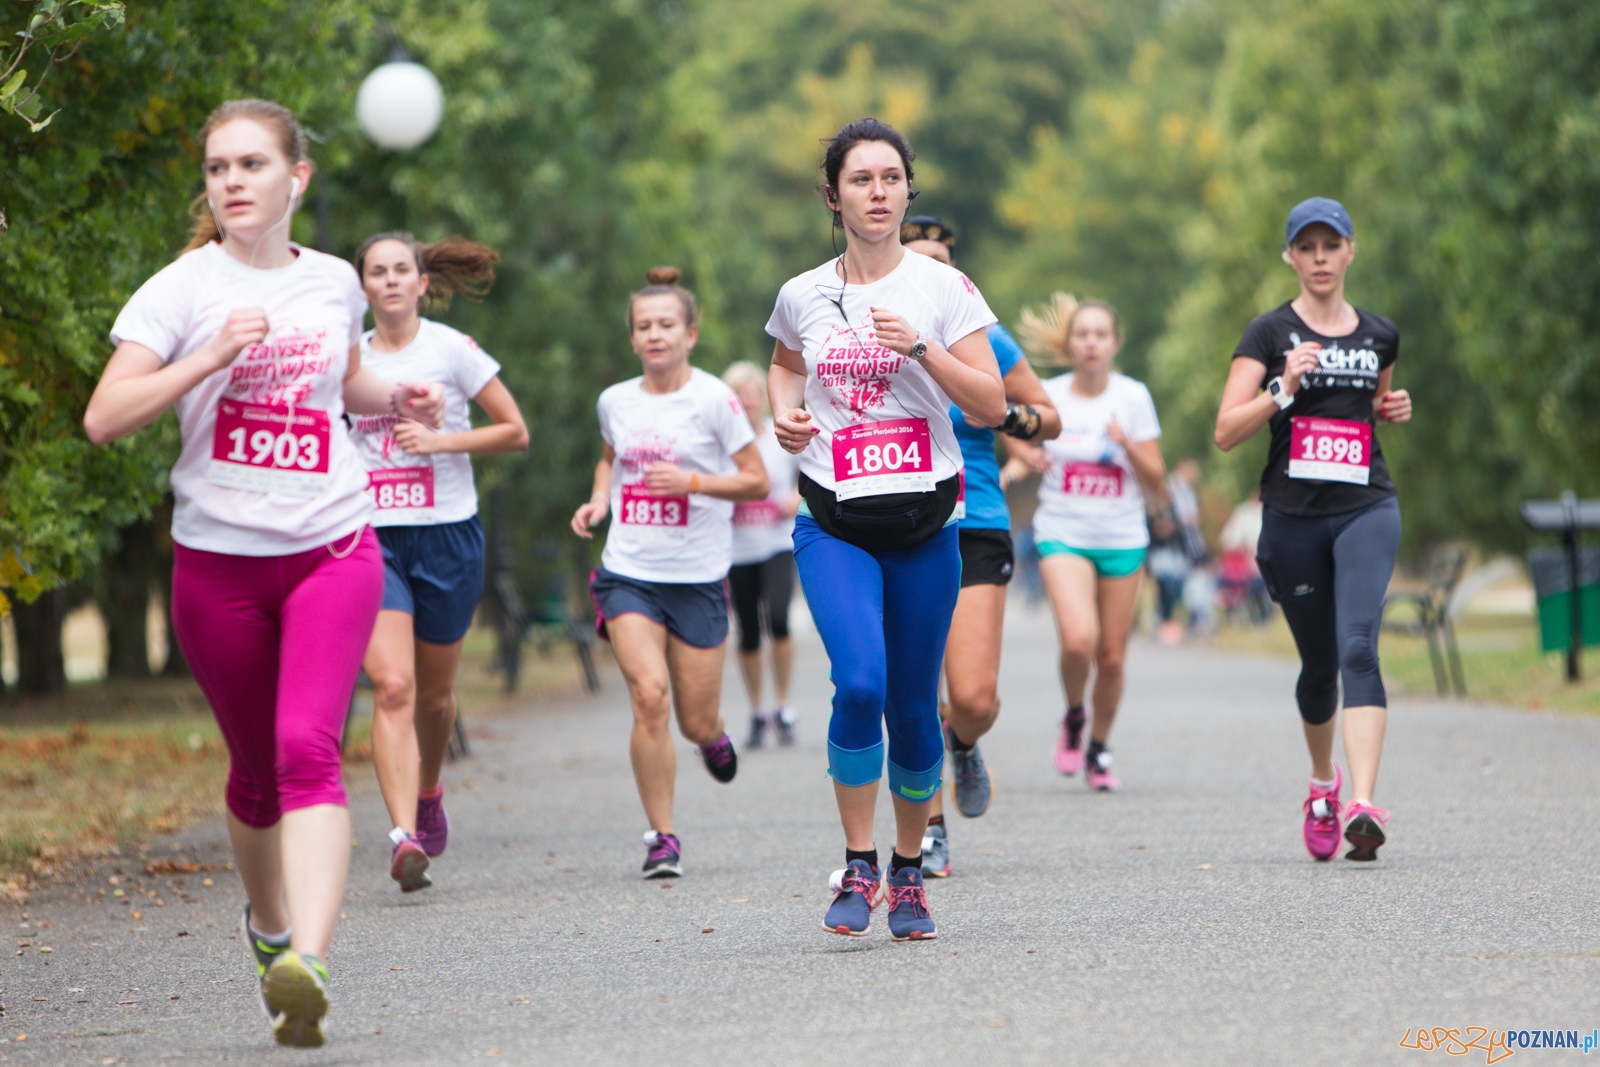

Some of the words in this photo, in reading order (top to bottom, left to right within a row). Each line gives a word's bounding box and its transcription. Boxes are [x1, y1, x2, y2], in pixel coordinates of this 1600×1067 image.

[246, 342, 321, 361] zawsze
[826, 346, 892, 360] zawsze
[816, 357, 902, 379] pier(w)si!
[822, 375, 847, 388] 2016
[851, 431, 873, 439] Zawsze
[898, 426, 914, 434] 2016
[227, 426, 321, 470] 1903
[844, 441, 922, 476] 1804
[1301, 435, 1363, 465] 1898
[366, 482, 426, 508] 1858
[625, 500, 681, 525] 1813
